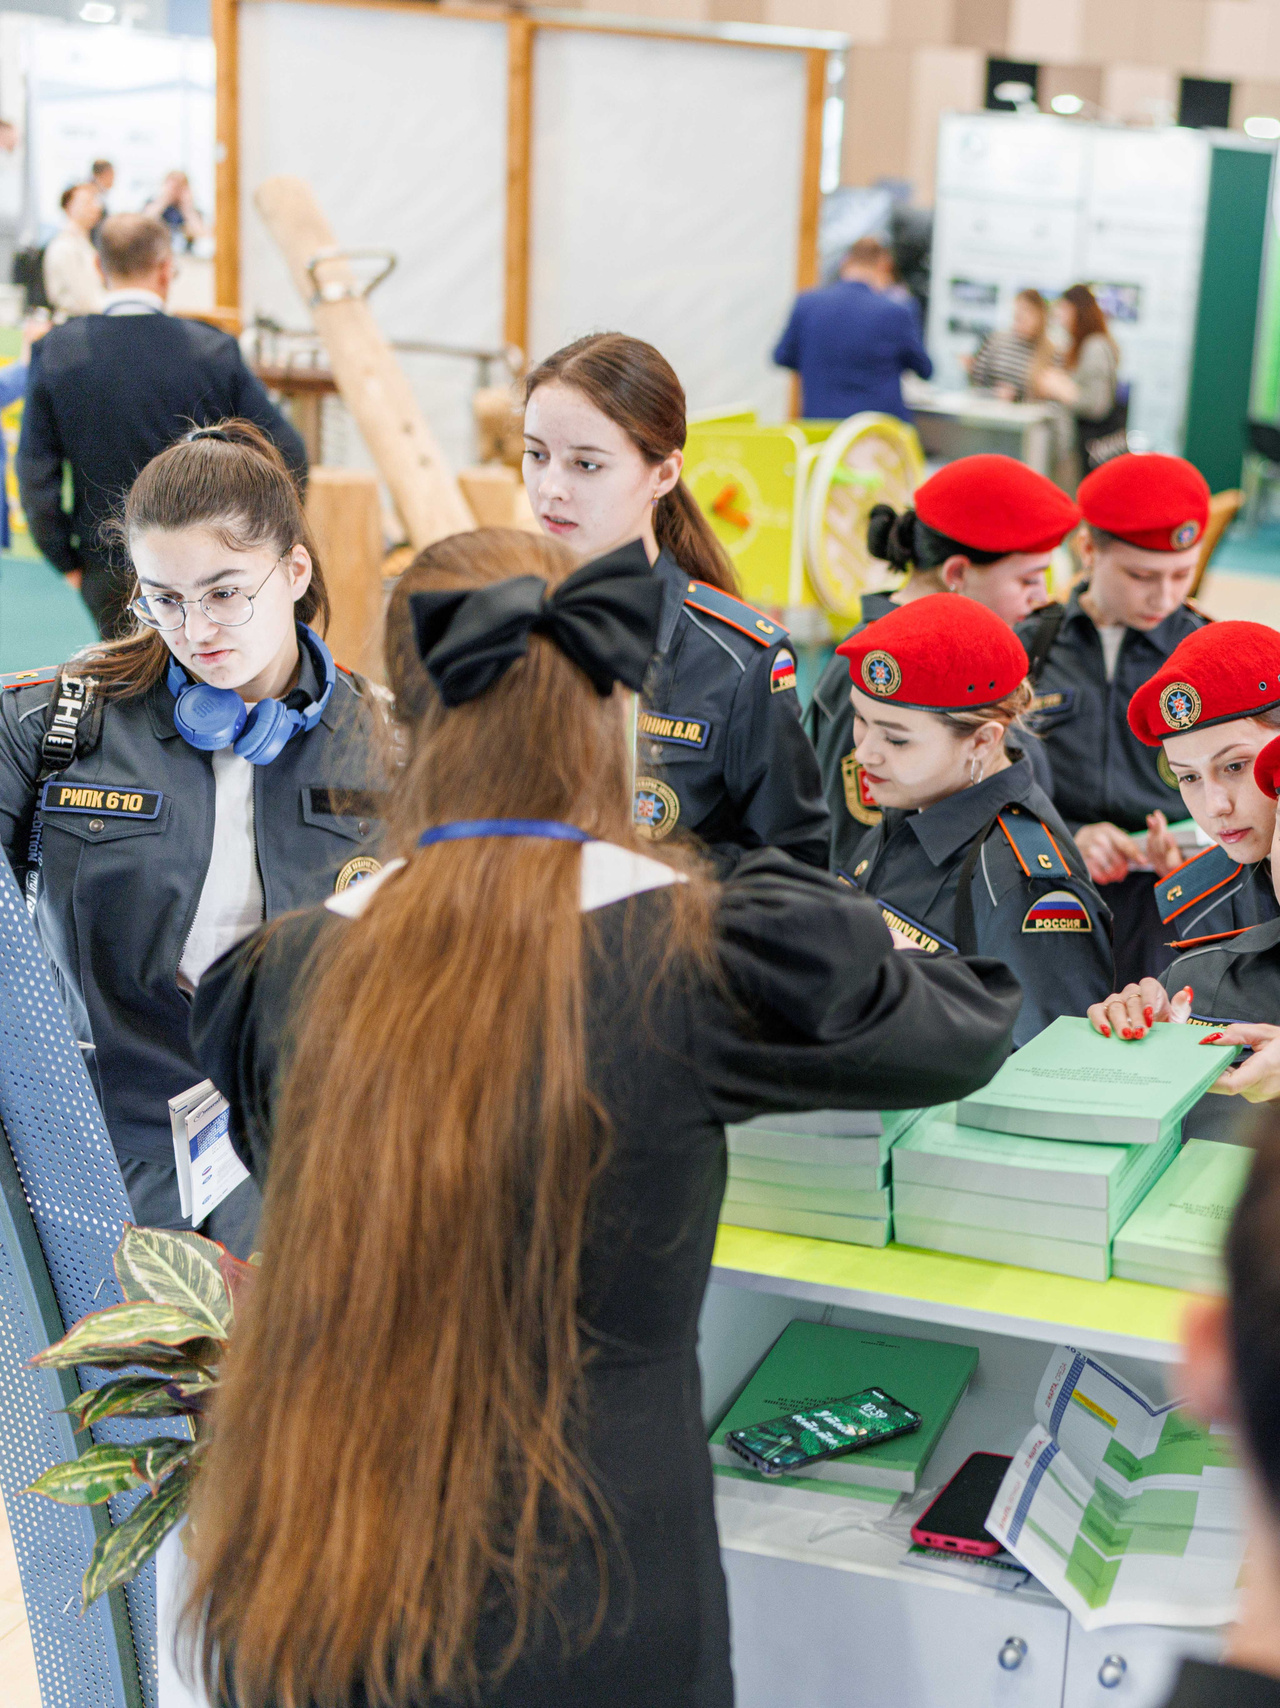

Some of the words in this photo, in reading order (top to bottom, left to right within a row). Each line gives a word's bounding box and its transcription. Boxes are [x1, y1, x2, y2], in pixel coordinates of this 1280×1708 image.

[59, 788, 104, 808] РИПК
[105, 792, 143, 811] 610
[1035, 918, 1081, 929] РОССИЯ
[860, 1402, 888, 1418] 10:39
